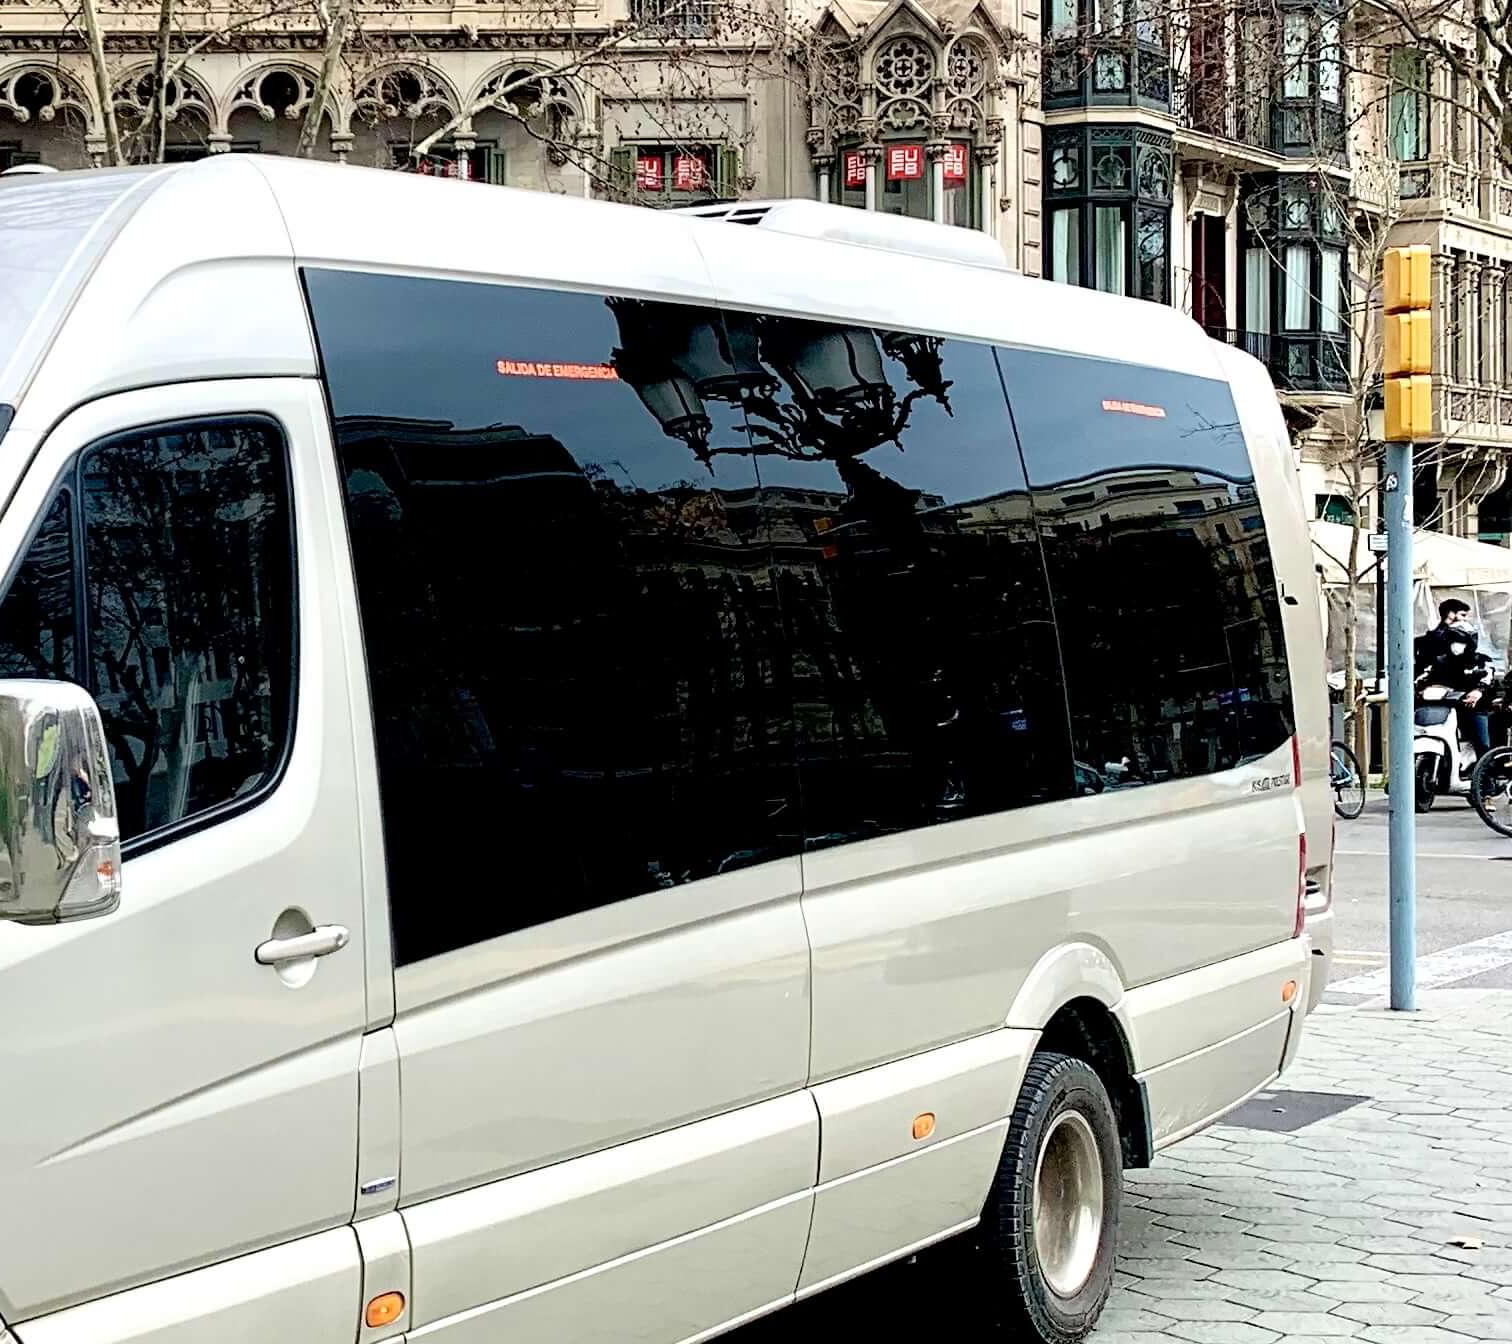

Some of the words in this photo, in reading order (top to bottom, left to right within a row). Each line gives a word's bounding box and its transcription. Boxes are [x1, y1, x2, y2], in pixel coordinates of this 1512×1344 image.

[848, 156, 866, 169] EU
[891, 150, 918, 162] EU
[848, 168, 866, 182] FB
[891, 162, 918, 176] FB
[944, 162, 963, 175] FB
[497, 360, 537, 376] SALIDA
[536, 363, 553, 377] DE
[552, 364, 620, 380] EMERGENCIA
